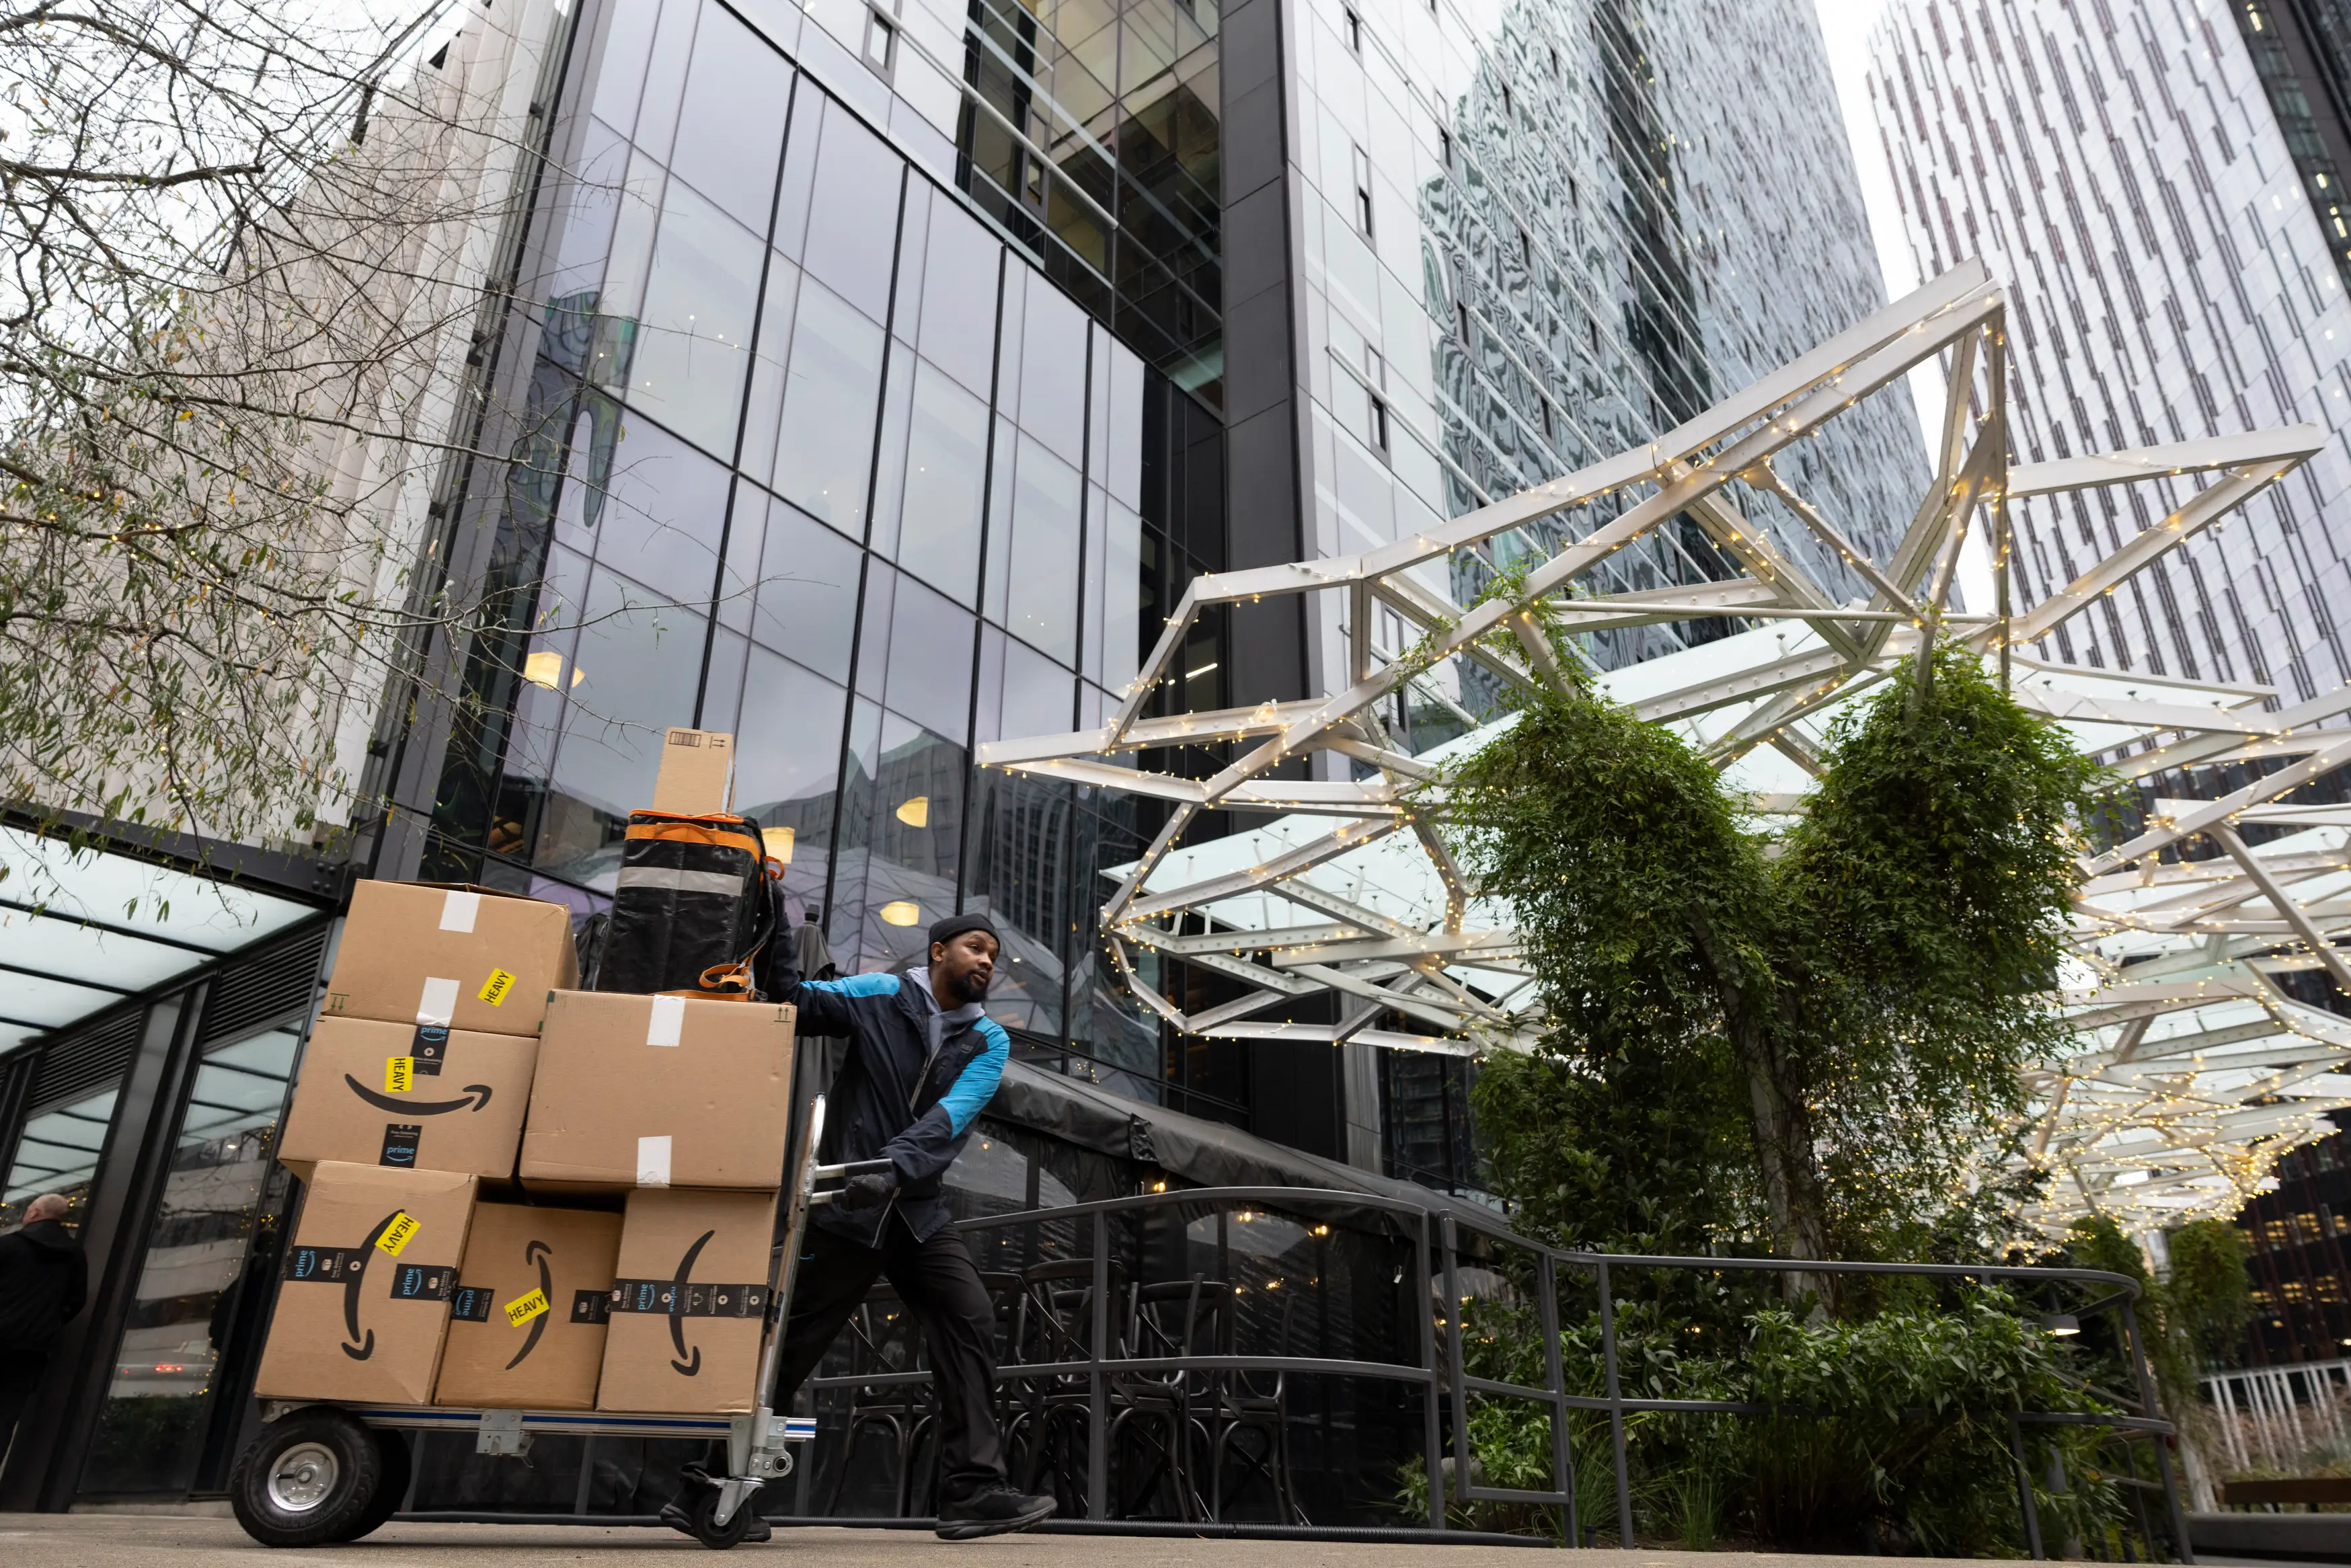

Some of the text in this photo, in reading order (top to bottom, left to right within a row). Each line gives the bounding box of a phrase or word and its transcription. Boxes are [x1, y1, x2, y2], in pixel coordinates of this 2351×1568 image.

[484, 972, 509, 1003] HEAVY
[420, 1026, 447, 1035] prime
[393, 1058, 406, 1091] HEAVY
[386, 1146, 415, 1154] prime
[383, 1217, 414, 1252] HEAVY
[295, 1251, 308, 1277] prime
[402, 1269, 415, 1295] prime
[462, 1290, 474, 1316] prime
[638, 1284, 648, 1310] prime
